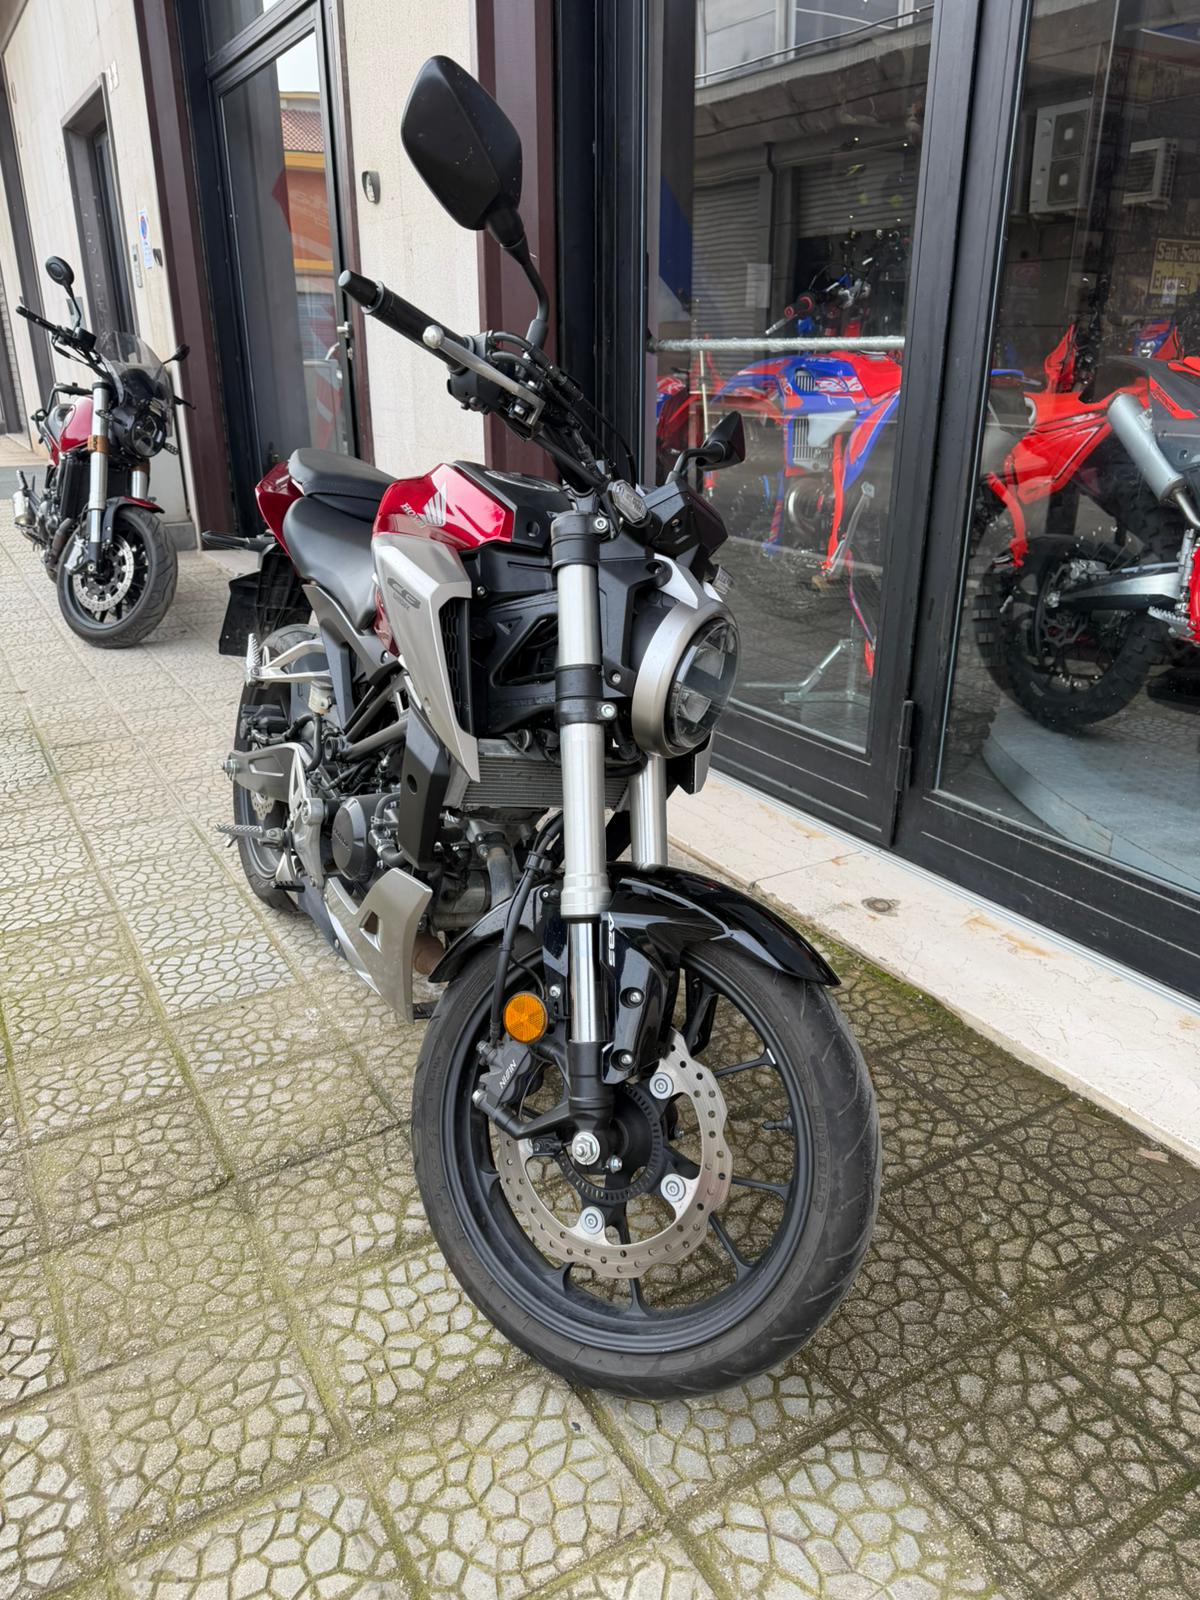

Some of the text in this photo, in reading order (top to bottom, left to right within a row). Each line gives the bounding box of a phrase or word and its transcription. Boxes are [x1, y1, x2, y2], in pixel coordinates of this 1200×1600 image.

[1157, 242, 1178, 260] San
[387, 577, 421, 610] CB
[608, 911, 616, 967] ABS
